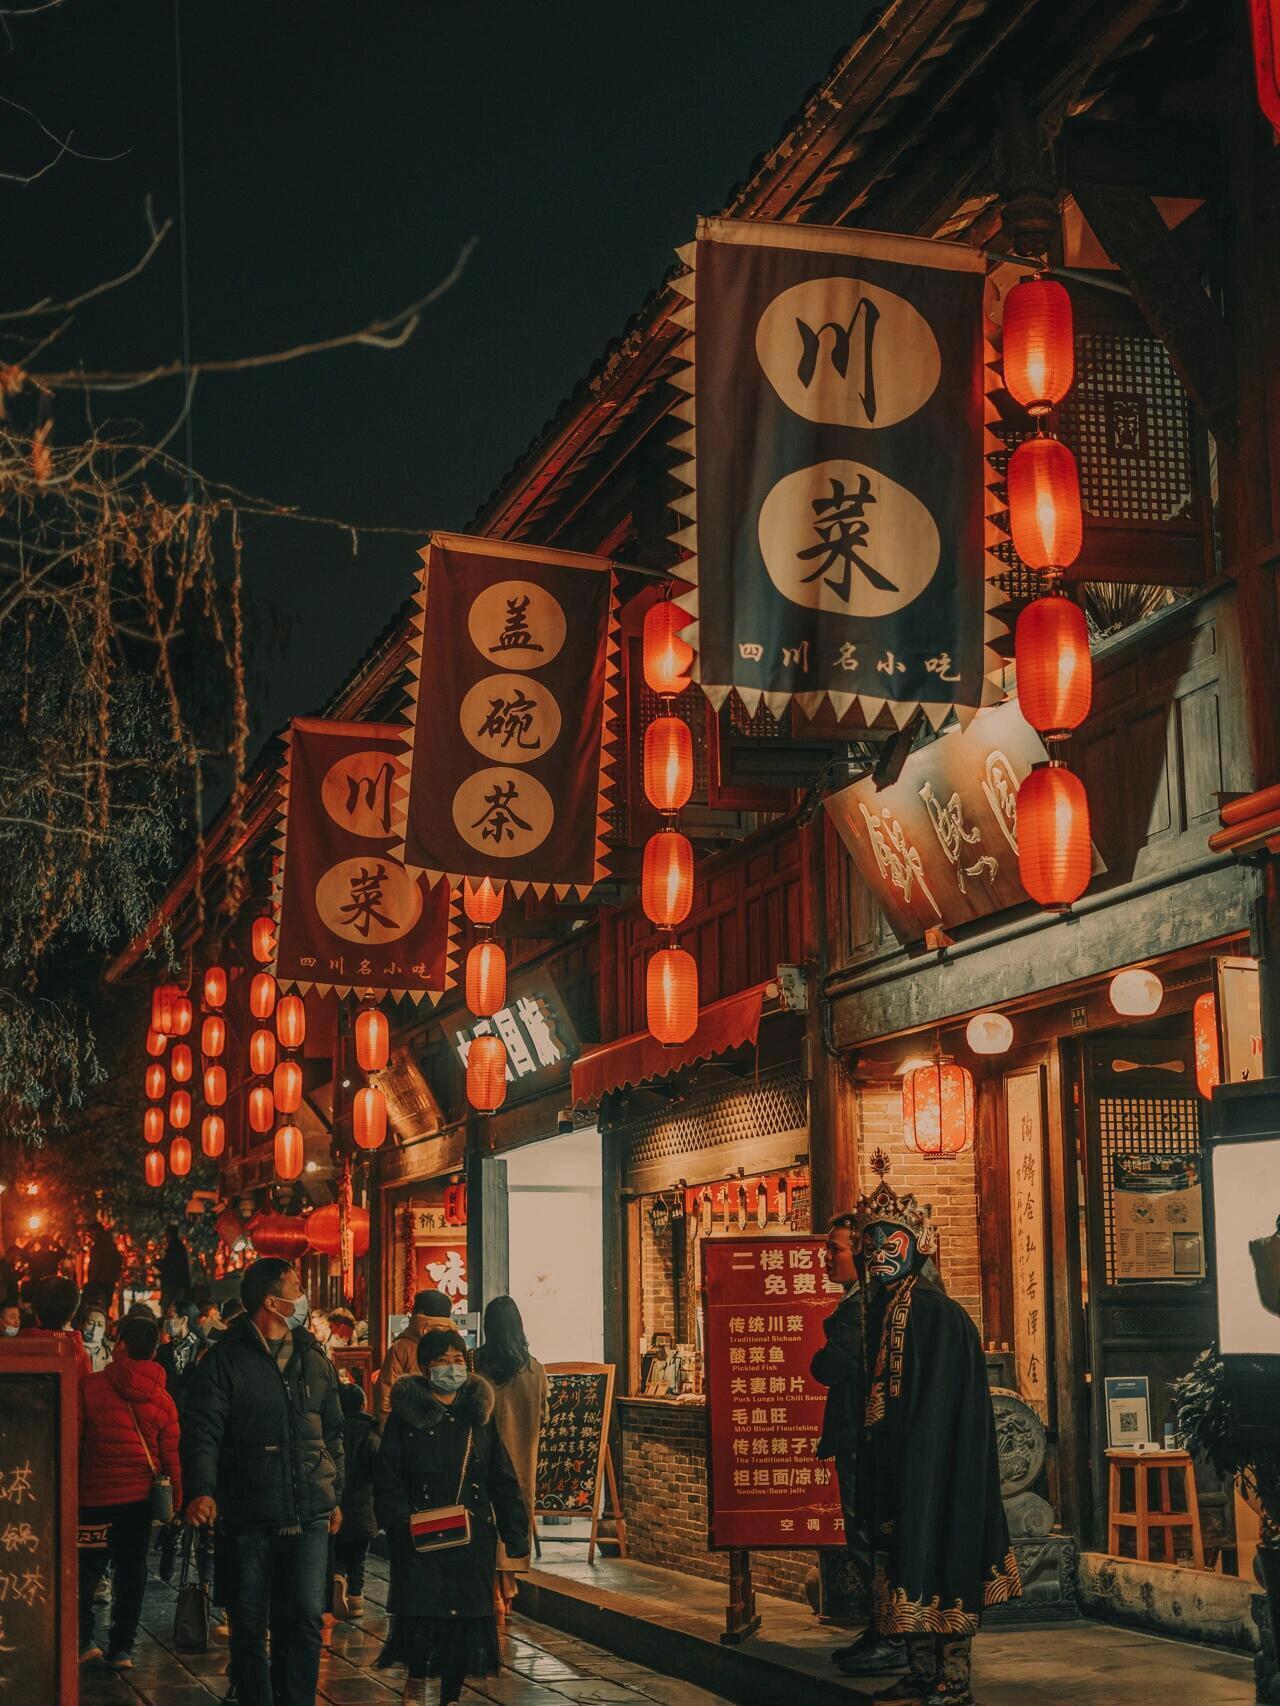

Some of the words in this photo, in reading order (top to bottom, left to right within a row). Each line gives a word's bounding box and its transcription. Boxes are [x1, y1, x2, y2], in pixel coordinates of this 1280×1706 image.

[795, 297, 900, 603] 川菜
[738, 640, 961, 683] 四川名小吃
[470, 595, 544, 844] 盖碗茶
[340, 762, 401, 937] 川菜
[729, 1315, 804, 1334] 传统川菜
[730, 1346, 785, 1364] 酸菜鱼
[731, 1376, 805, 1394] 夫妻肺片
[732, 1408, 787, 1424] 毛血旺
[733, 1468, 831, 1486] 担担面/凉粉
